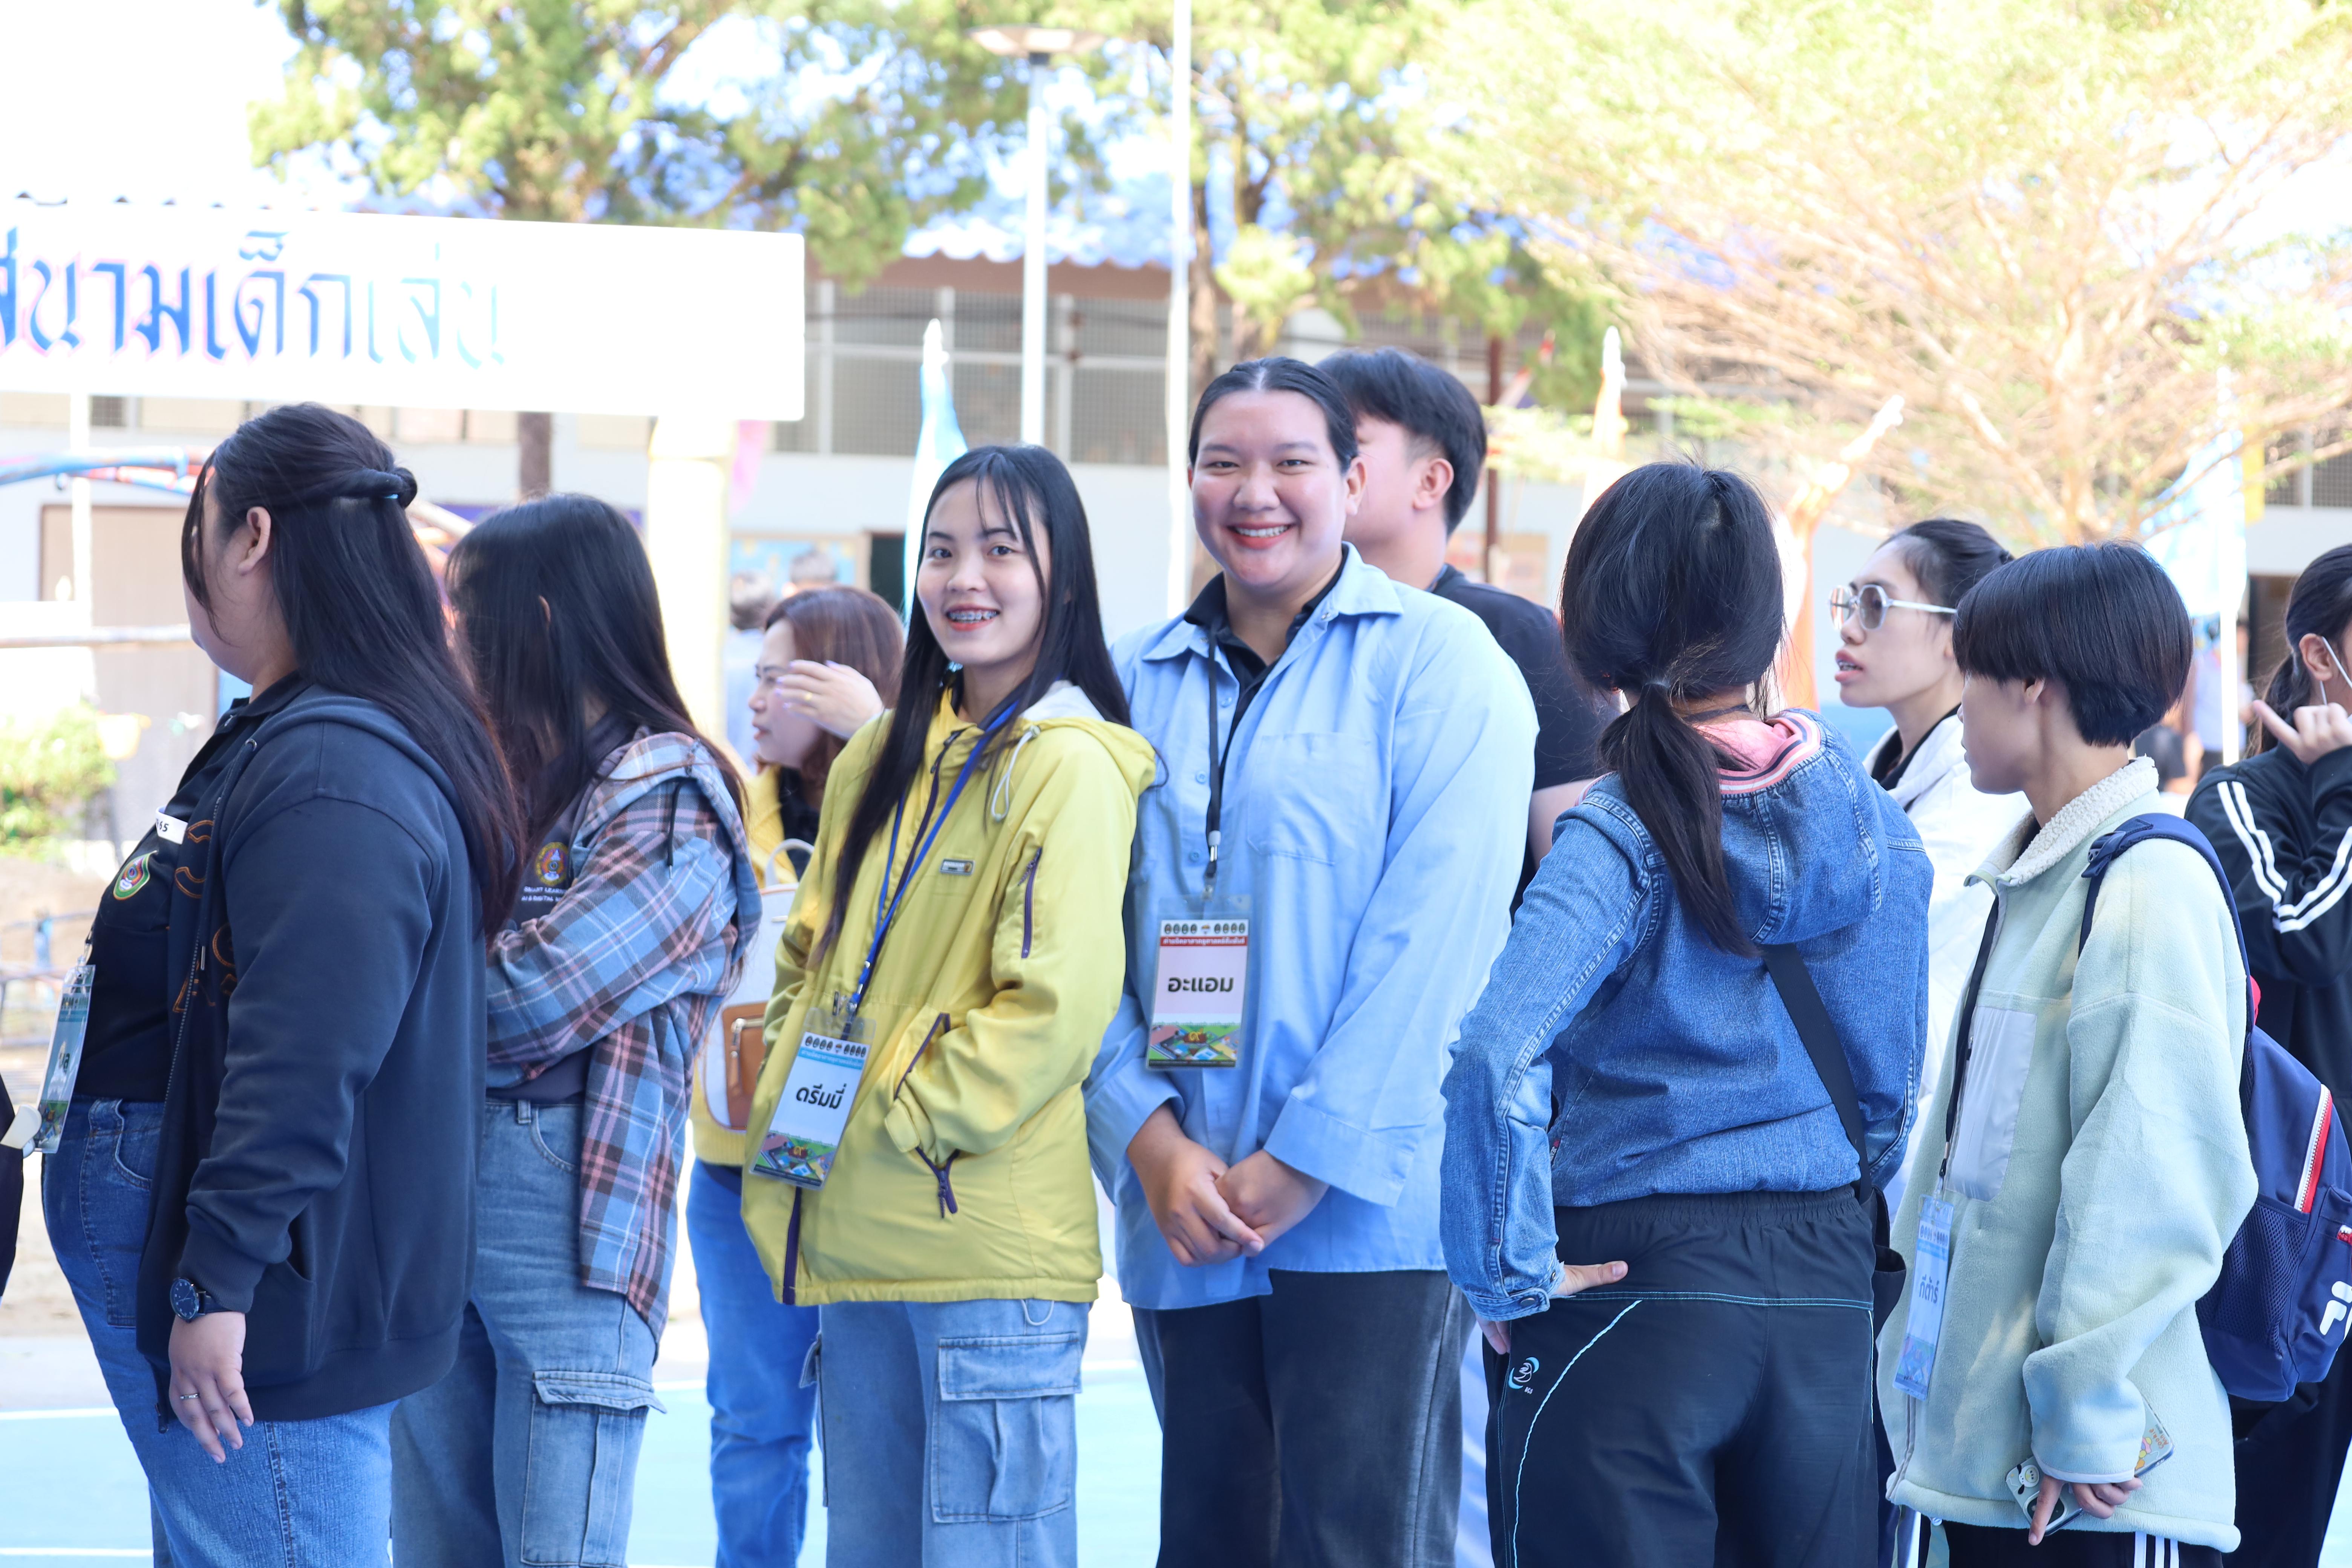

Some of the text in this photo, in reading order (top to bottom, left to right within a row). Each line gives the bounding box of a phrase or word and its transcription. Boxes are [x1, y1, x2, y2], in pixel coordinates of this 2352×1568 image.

[1168, 977, 1234, 992] อะแอม
[796, 1083, 847, 1109] ดรีมมี่
[1919, 1274, 1940, 1304] กีต้าร์
